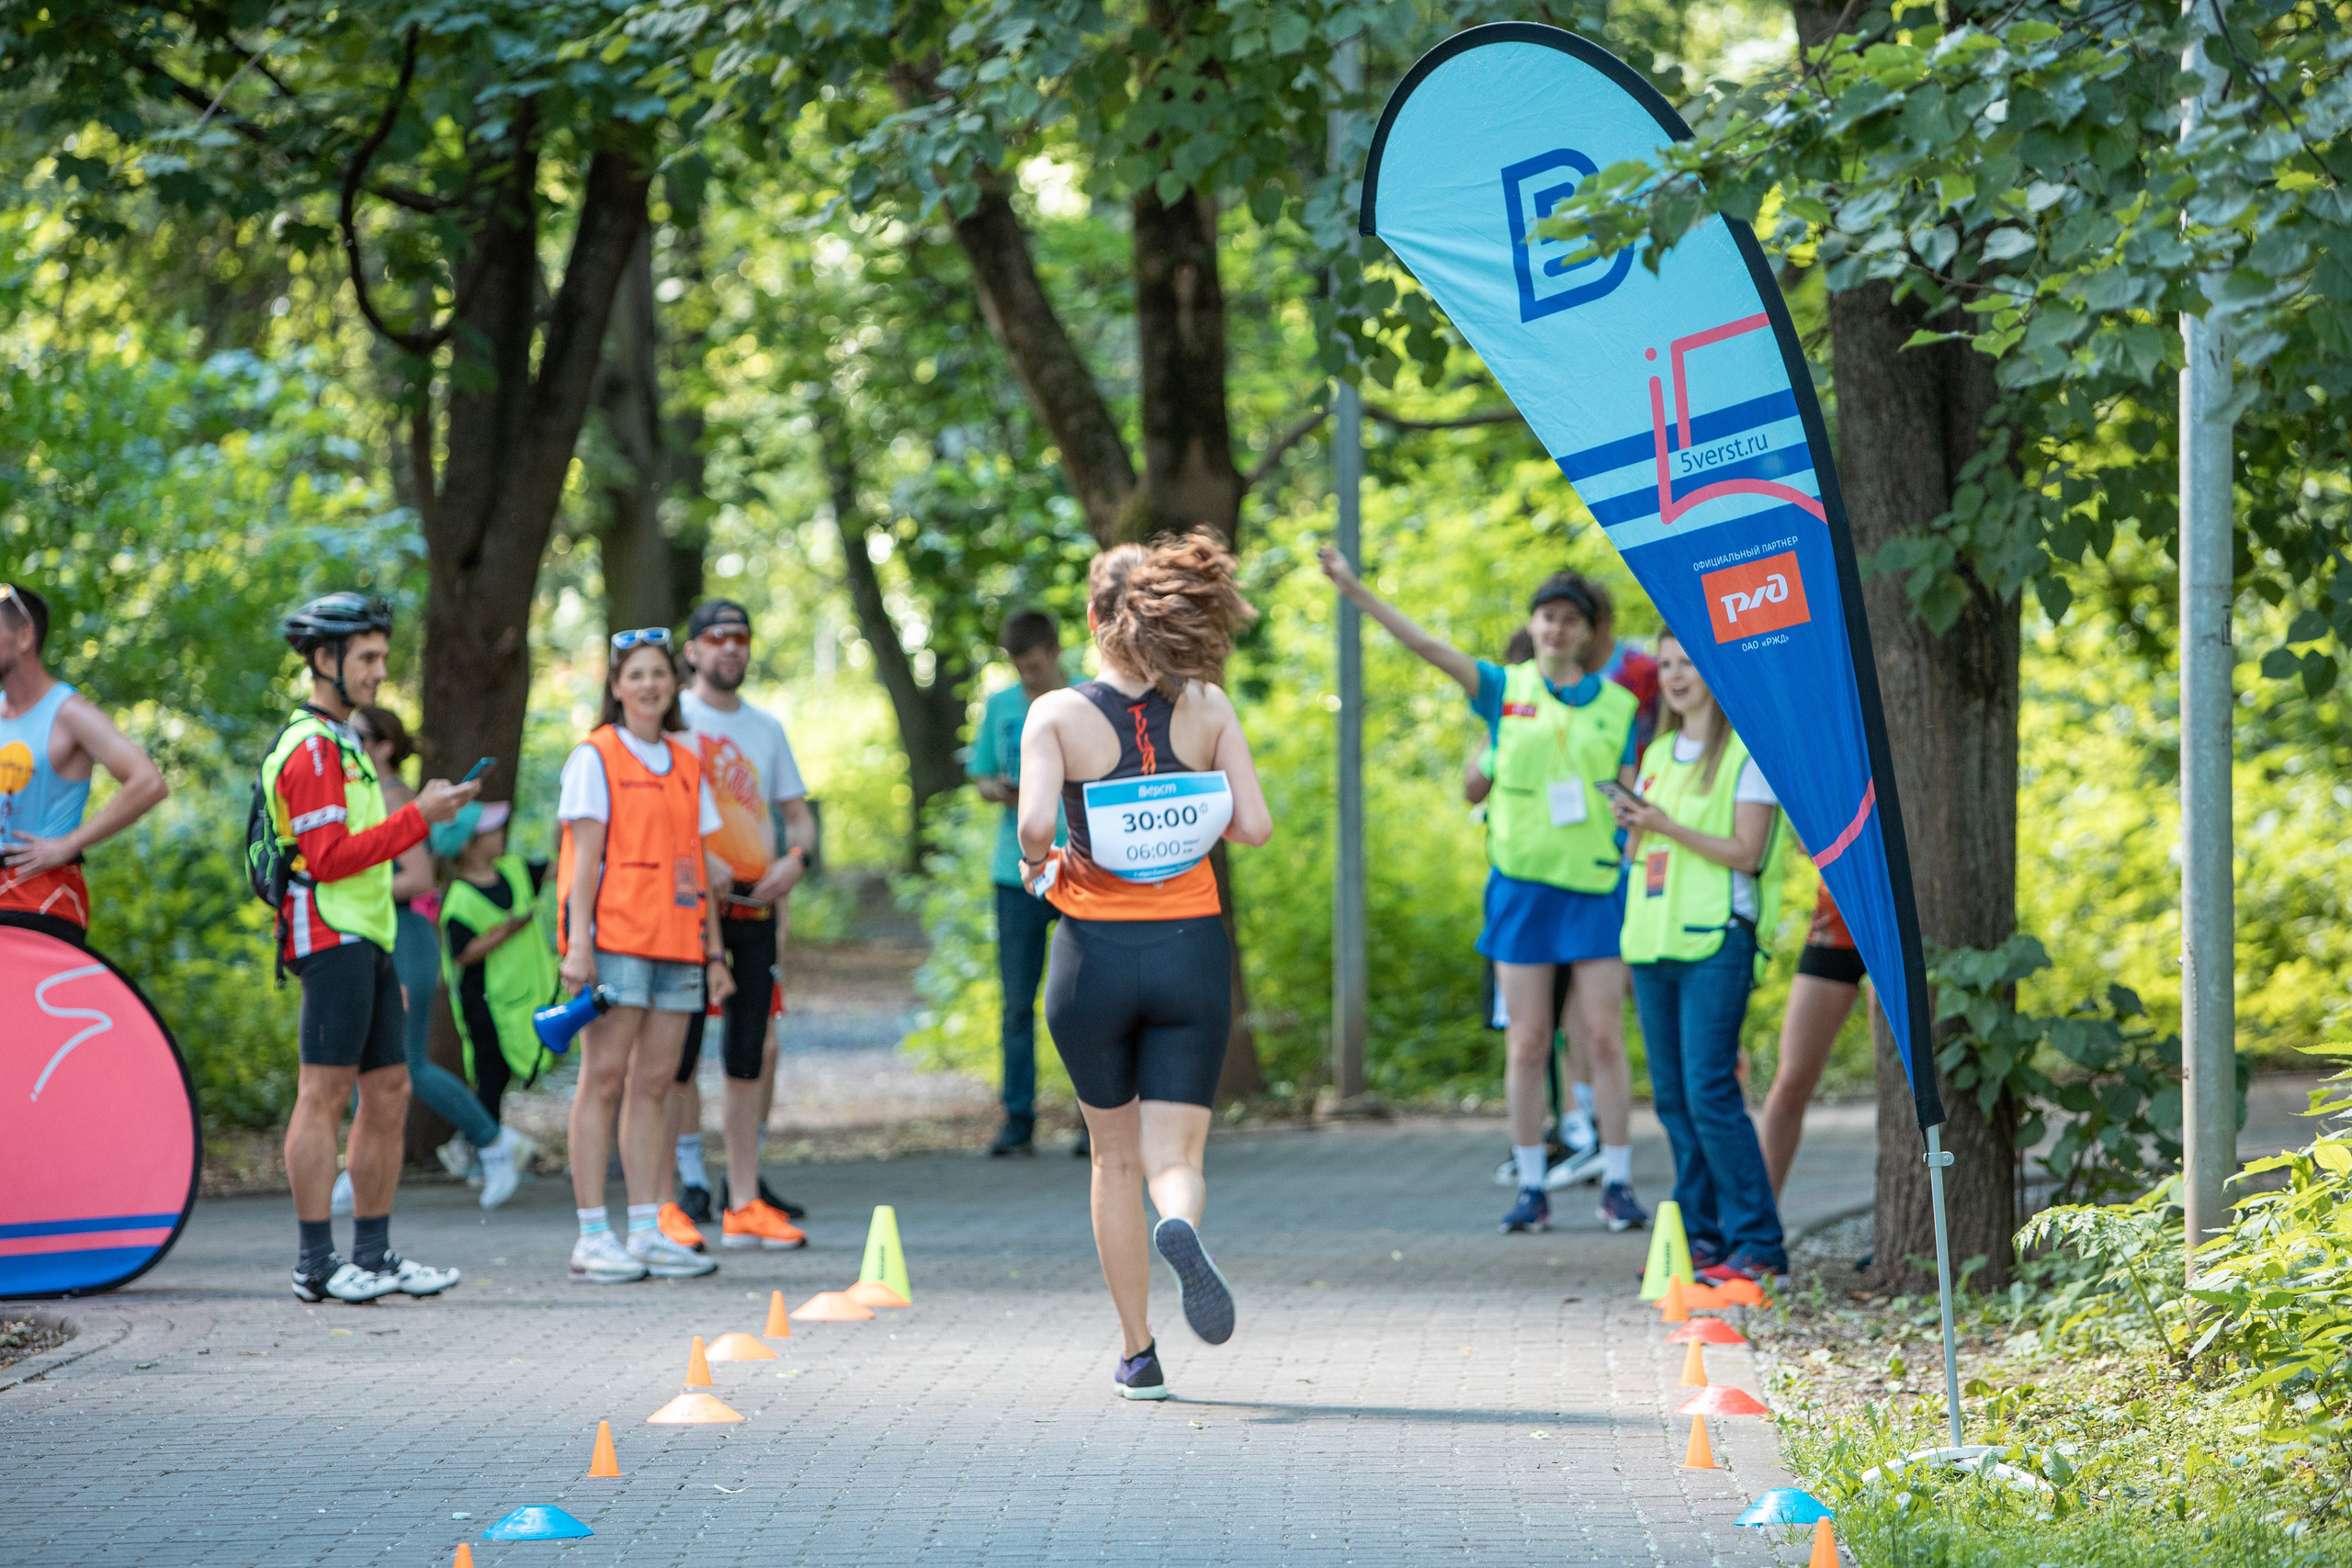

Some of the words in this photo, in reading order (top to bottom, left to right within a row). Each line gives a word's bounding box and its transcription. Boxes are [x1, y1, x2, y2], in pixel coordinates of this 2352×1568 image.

[1680, 434, 1769, 473] 5verst.ru
[1692, 545, 1760, 571] ОФИЦИАЛЬНЫЙ
[1762, 536, 1798, 553] ПАРТНЕР
[1742, 640, 1758, 651] ОАО
[1761, 634, 1790, 647] «РЖД»
[1123, 806, 1197, 832] 30:00
[1126, 840, 1181, 861] 06:00
